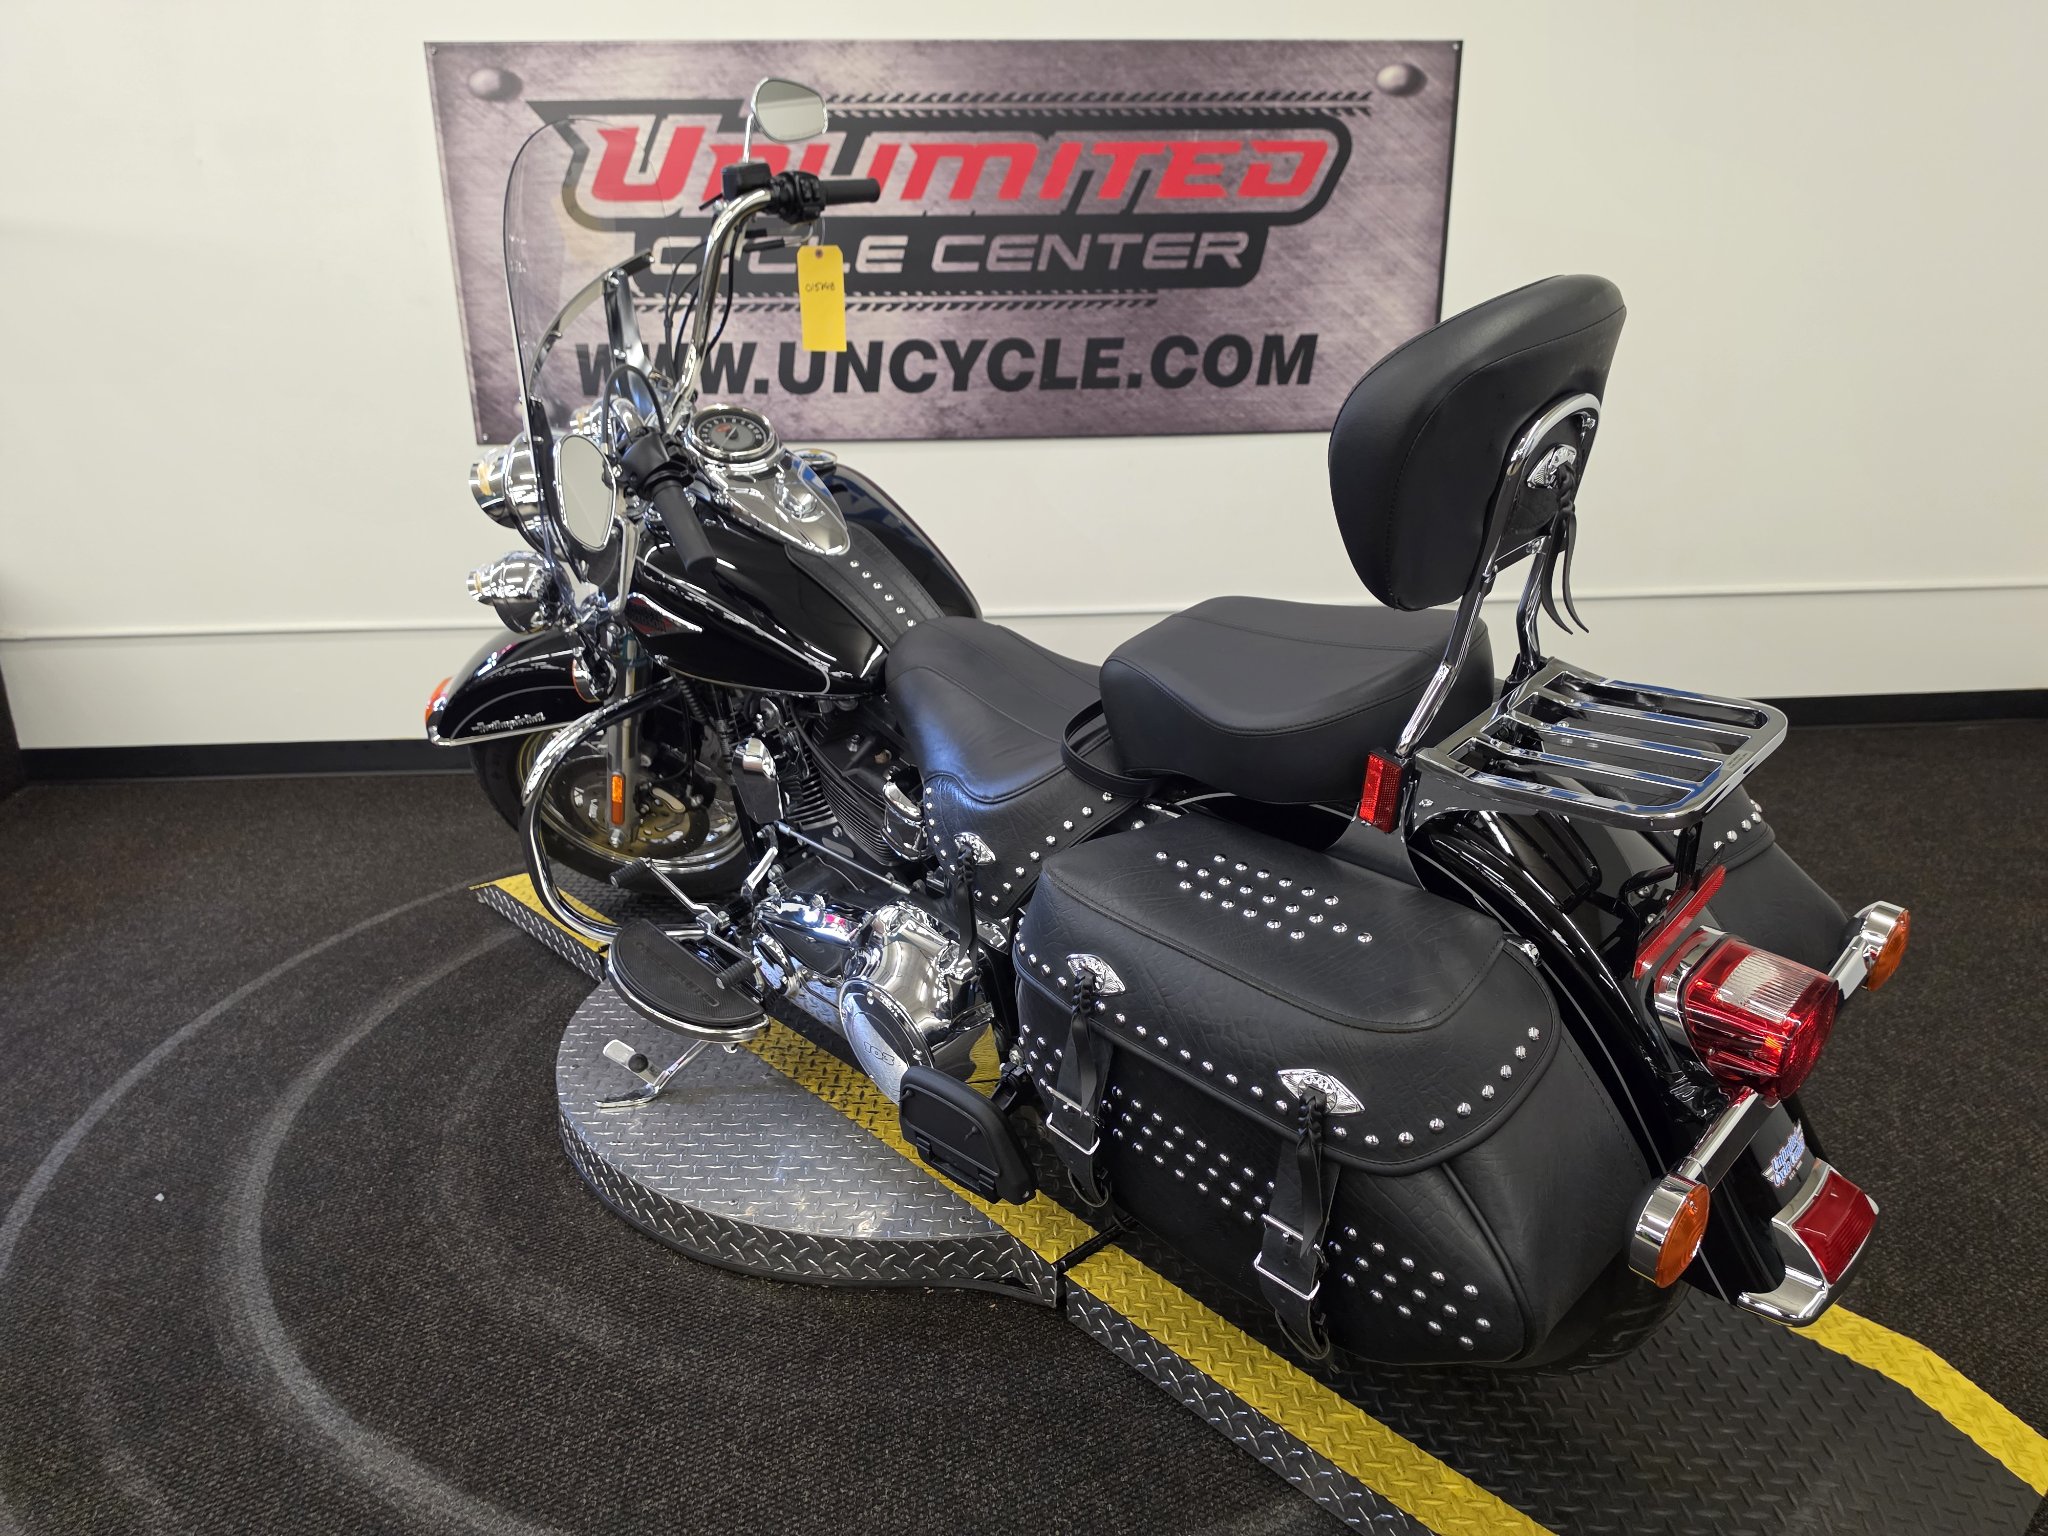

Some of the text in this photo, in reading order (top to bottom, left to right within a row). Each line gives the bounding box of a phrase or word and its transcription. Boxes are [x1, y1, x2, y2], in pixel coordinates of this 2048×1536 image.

[650, 232, 1250, 275] CCE CENTER
[863, 1041, 895, 1066] 103
